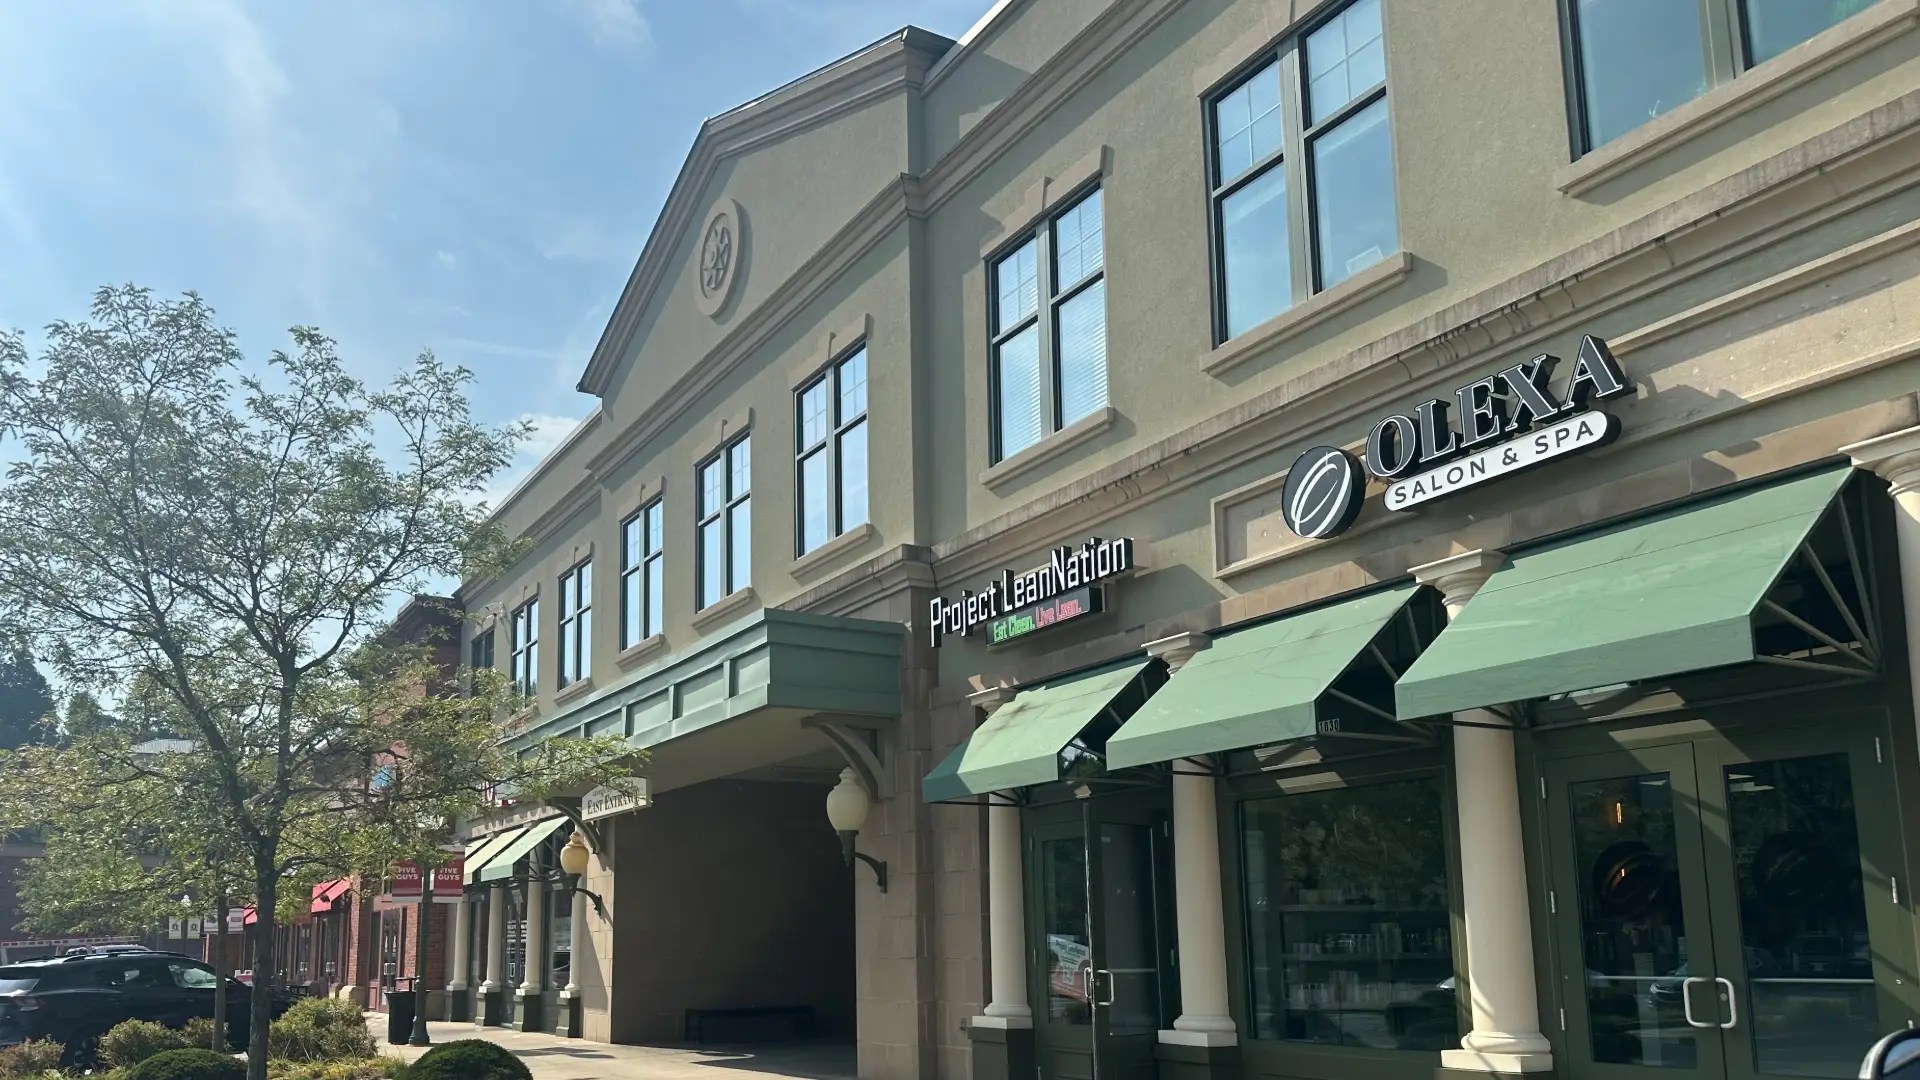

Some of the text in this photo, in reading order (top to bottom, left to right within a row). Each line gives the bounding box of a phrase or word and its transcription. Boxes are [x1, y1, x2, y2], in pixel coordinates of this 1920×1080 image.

[1365, 334, 1624, 478] OLEXA
[1394, 420, 1595, 505] SALON & SPA
[929, 537, 1128, 648] Project LeanNation
[993, 621, 1008, 642] Eat
[1036, 605, 1055, 629] Live
